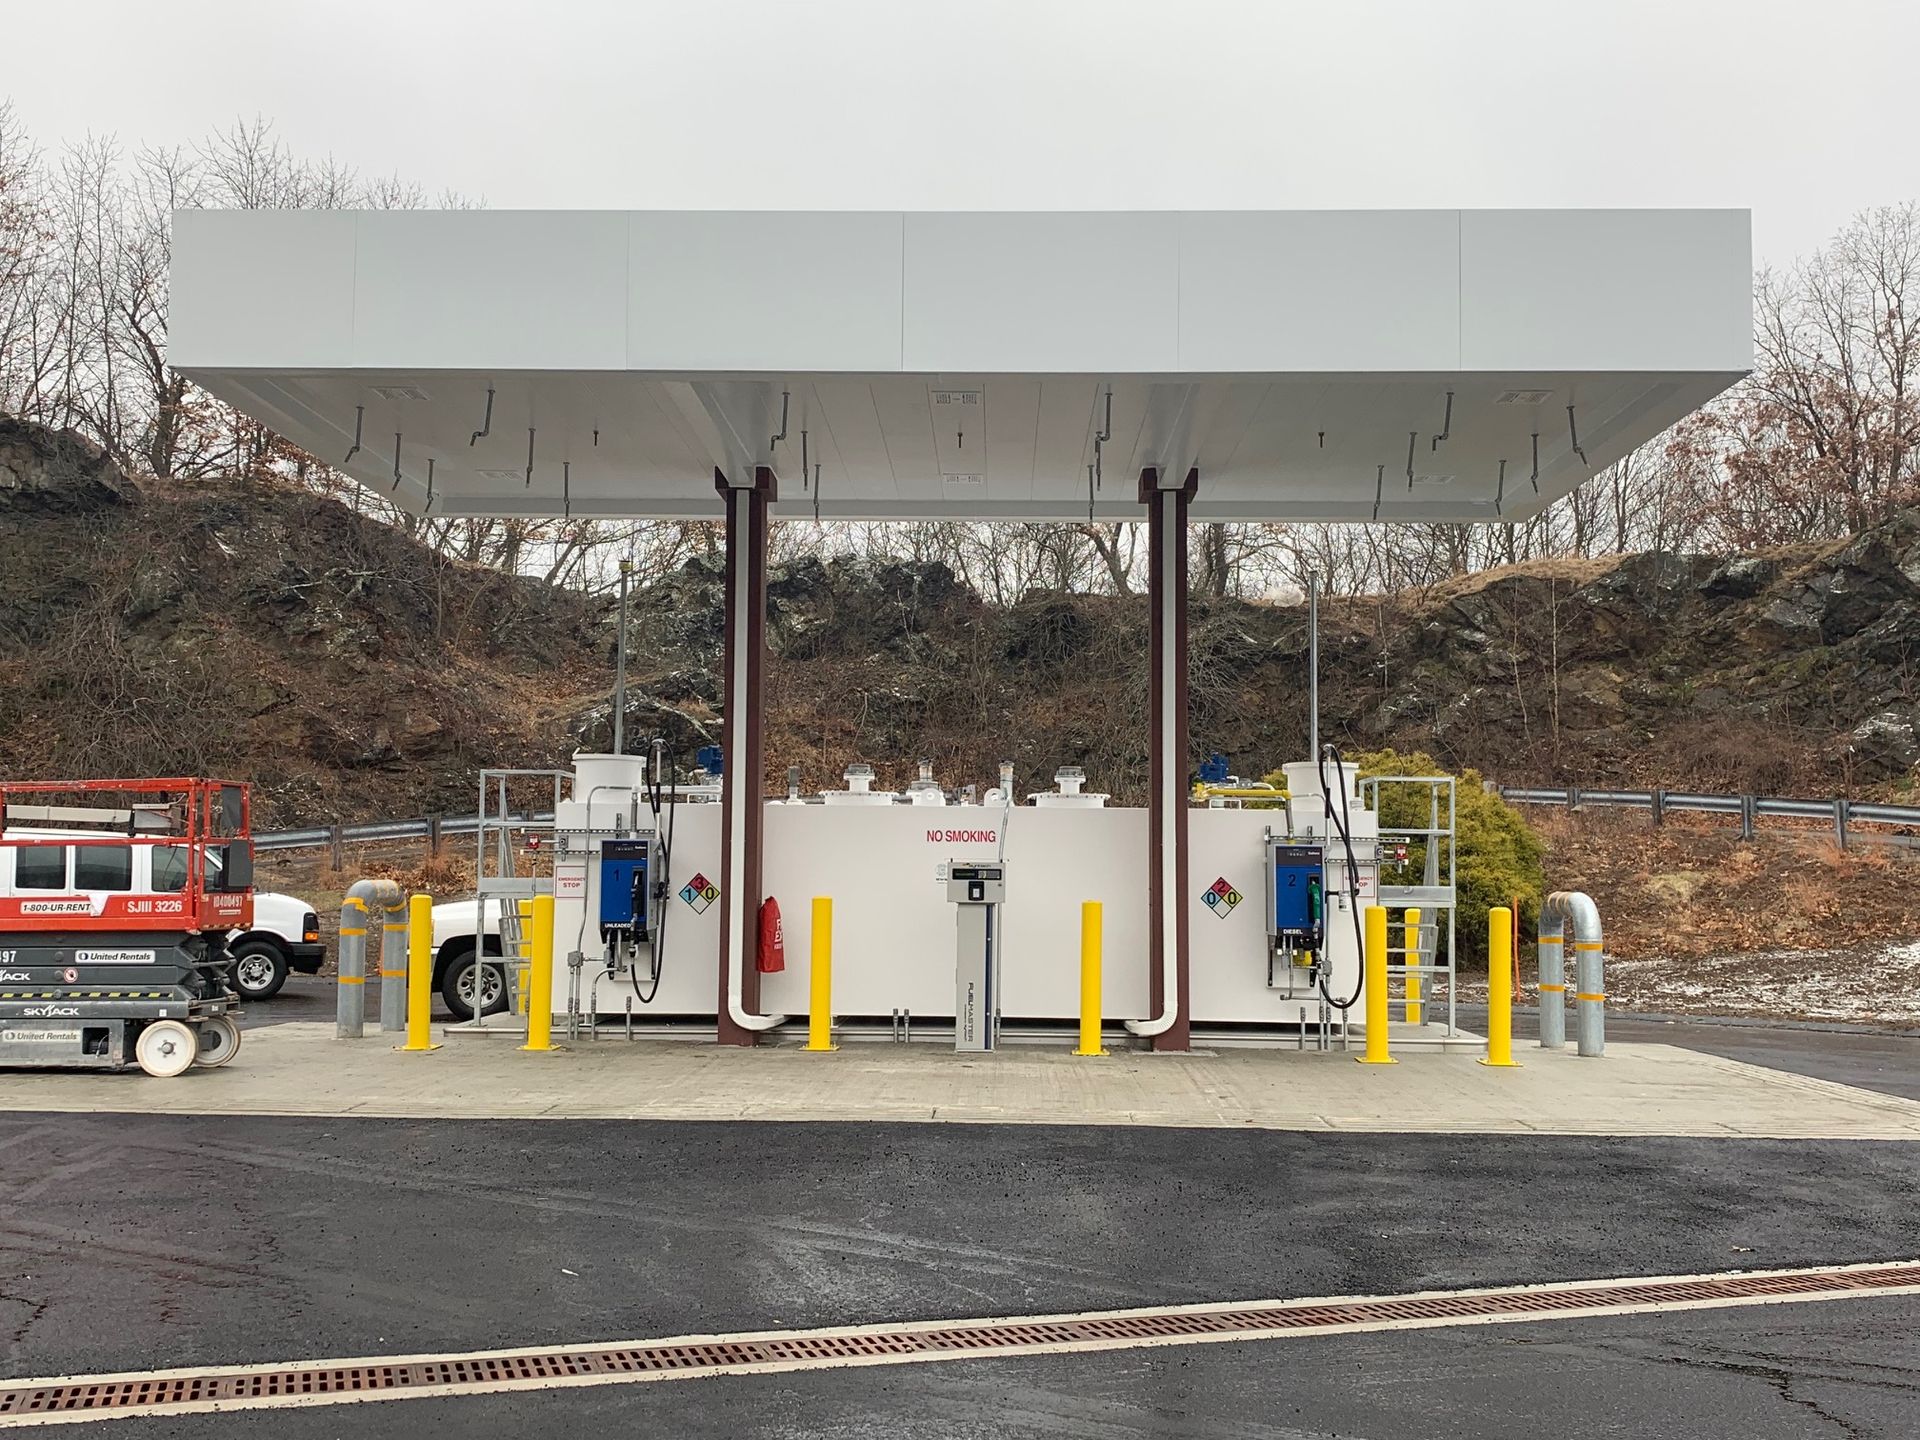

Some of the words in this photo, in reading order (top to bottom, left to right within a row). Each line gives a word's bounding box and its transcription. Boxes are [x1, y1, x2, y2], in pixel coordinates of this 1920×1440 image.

[926, 830, 943, 842] NO
[945, 830, 996, 842] SMOKING
[613, 869, 620, 882] 1
[1287, 874, 1297, 887] 2
[694, 877, 704, 890] 3
[1217, 881, 1226, 893] 2
[685, 887, 692, 901] 1
[705, 886, 715, 900] 0
[1206, 891, 1216, 905] 0
[1228, 891, 1237, 905] 0
[23, 903, 91, 912] 1-800-UR-RENT
[127, 900, 152, 913] SJIII
[155, 900, 183, 912] 3226
[90, 952, 119, 961] United
[23, 1004, 80, 1017] SKYJACK
[967, 982, 975, 1042] FUELMASTER
[17, 1032, 45, 1040] United
[46, 1032, 77, 1040] Rentals
